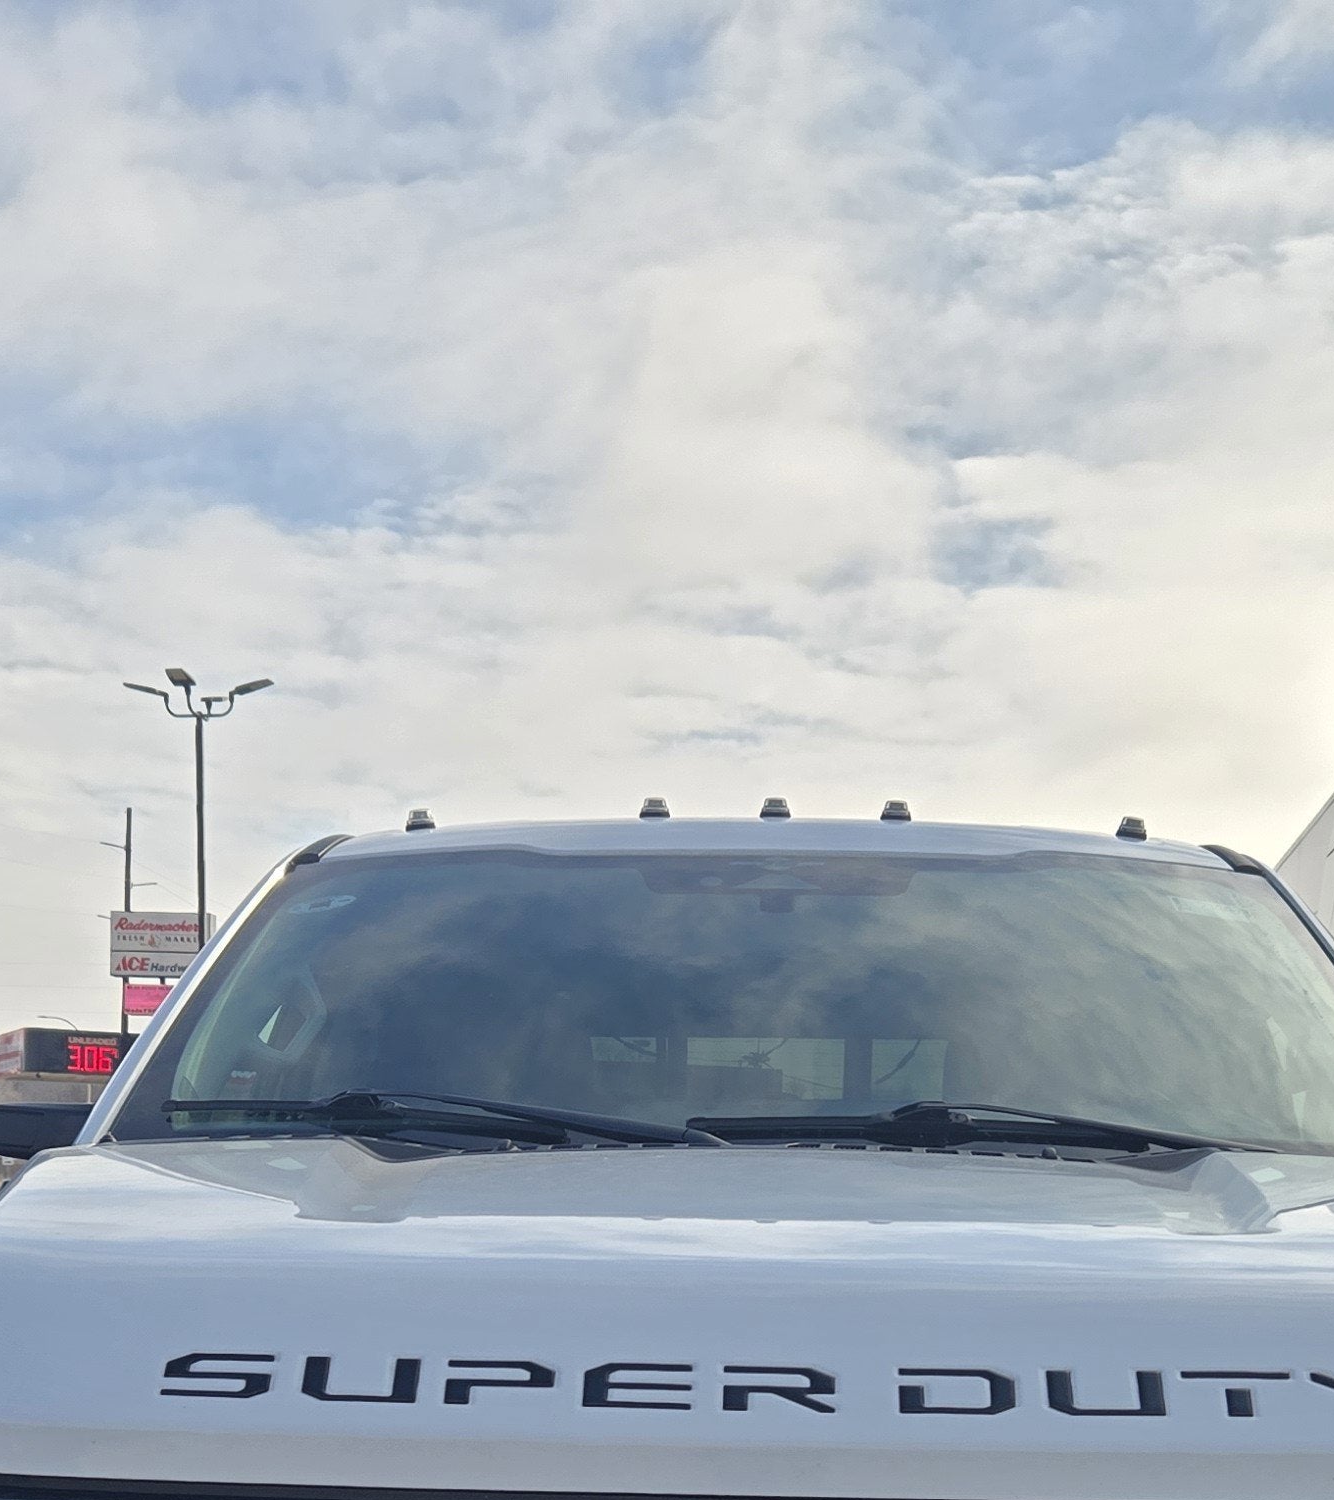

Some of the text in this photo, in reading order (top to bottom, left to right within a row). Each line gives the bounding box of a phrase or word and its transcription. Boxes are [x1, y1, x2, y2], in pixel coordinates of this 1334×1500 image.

[114, 918, 201, 932] Radermacher
[115, 956, 188, 973] ACE Hardw
[67, 1036, 117, 1045] UNLEADED
[159, 1352, 838, 1415] SUPER
